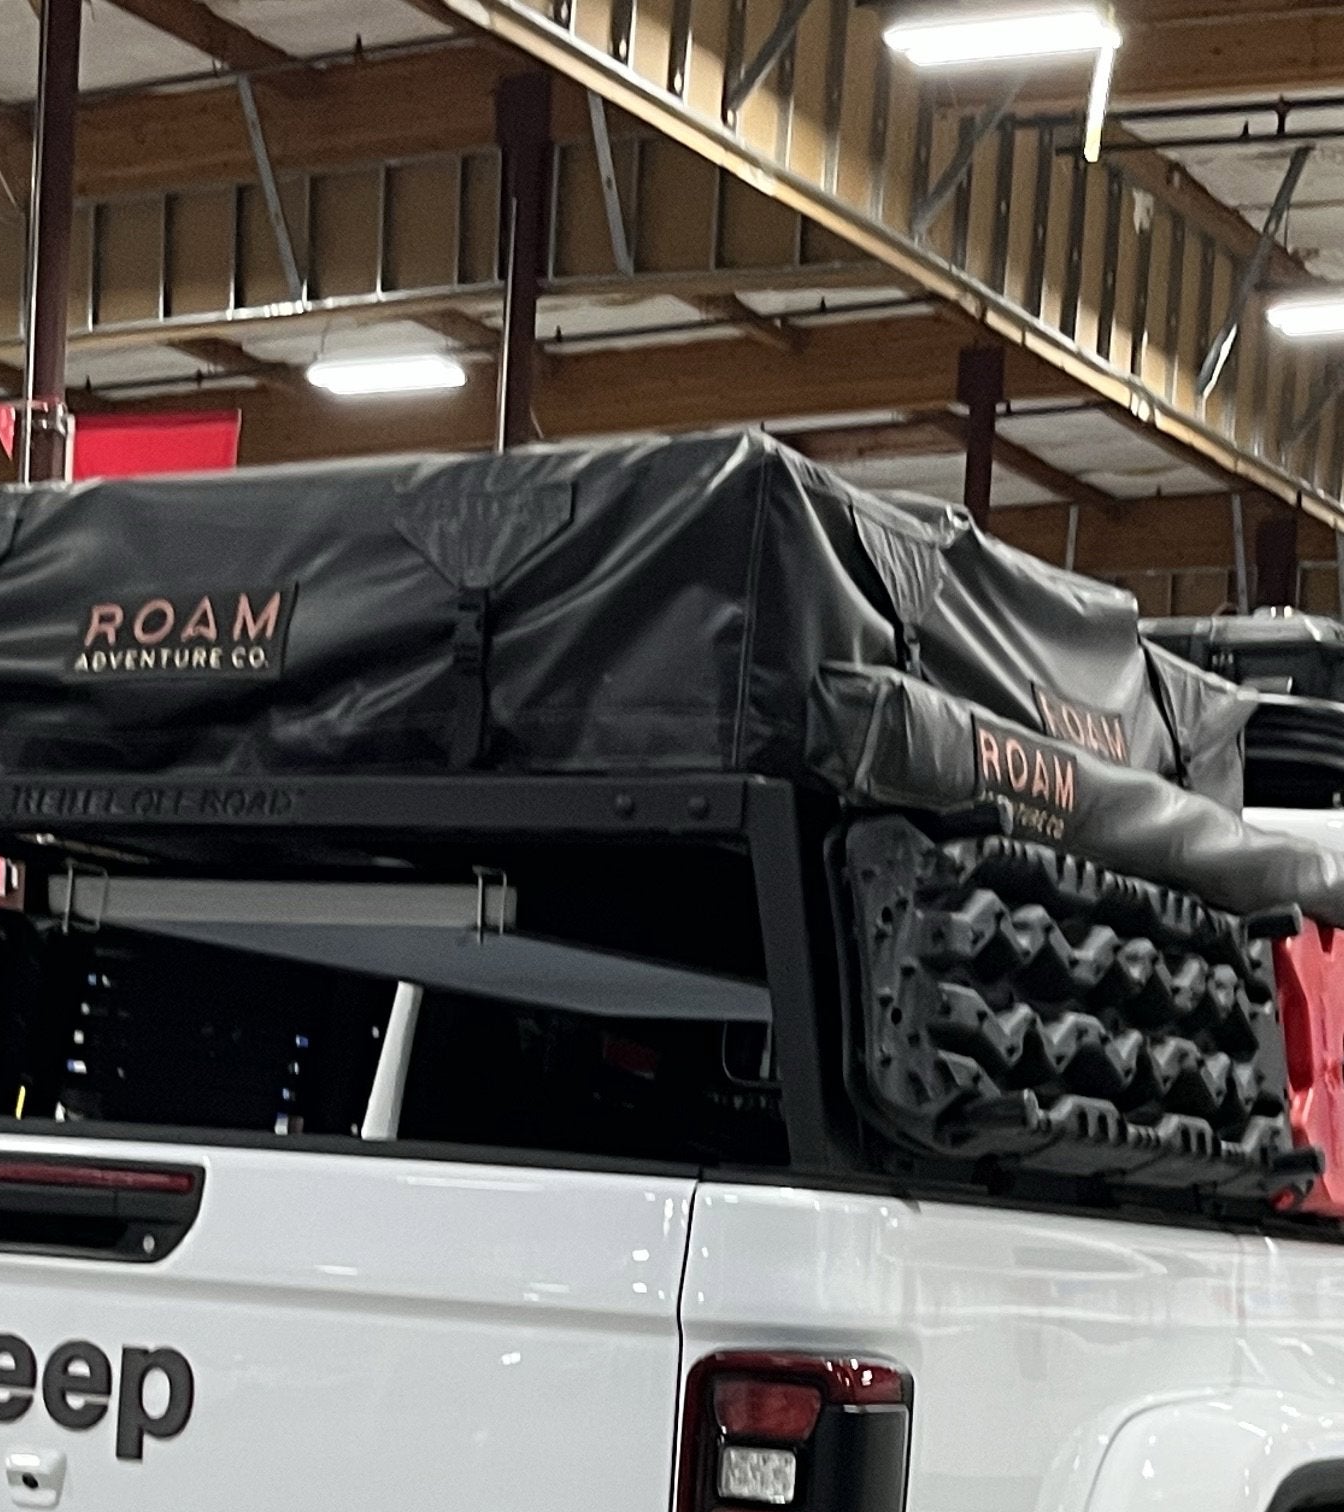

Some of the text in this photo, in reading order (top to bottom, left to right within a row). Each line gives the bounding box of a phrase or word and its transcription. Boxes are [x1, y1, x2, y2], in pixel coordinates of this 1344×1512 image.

[84, 591, 281, 647] ROAM
[74, 645, 269, 672] ADVENTURE CO.
[979, 728, 1074, 813] ROAM
